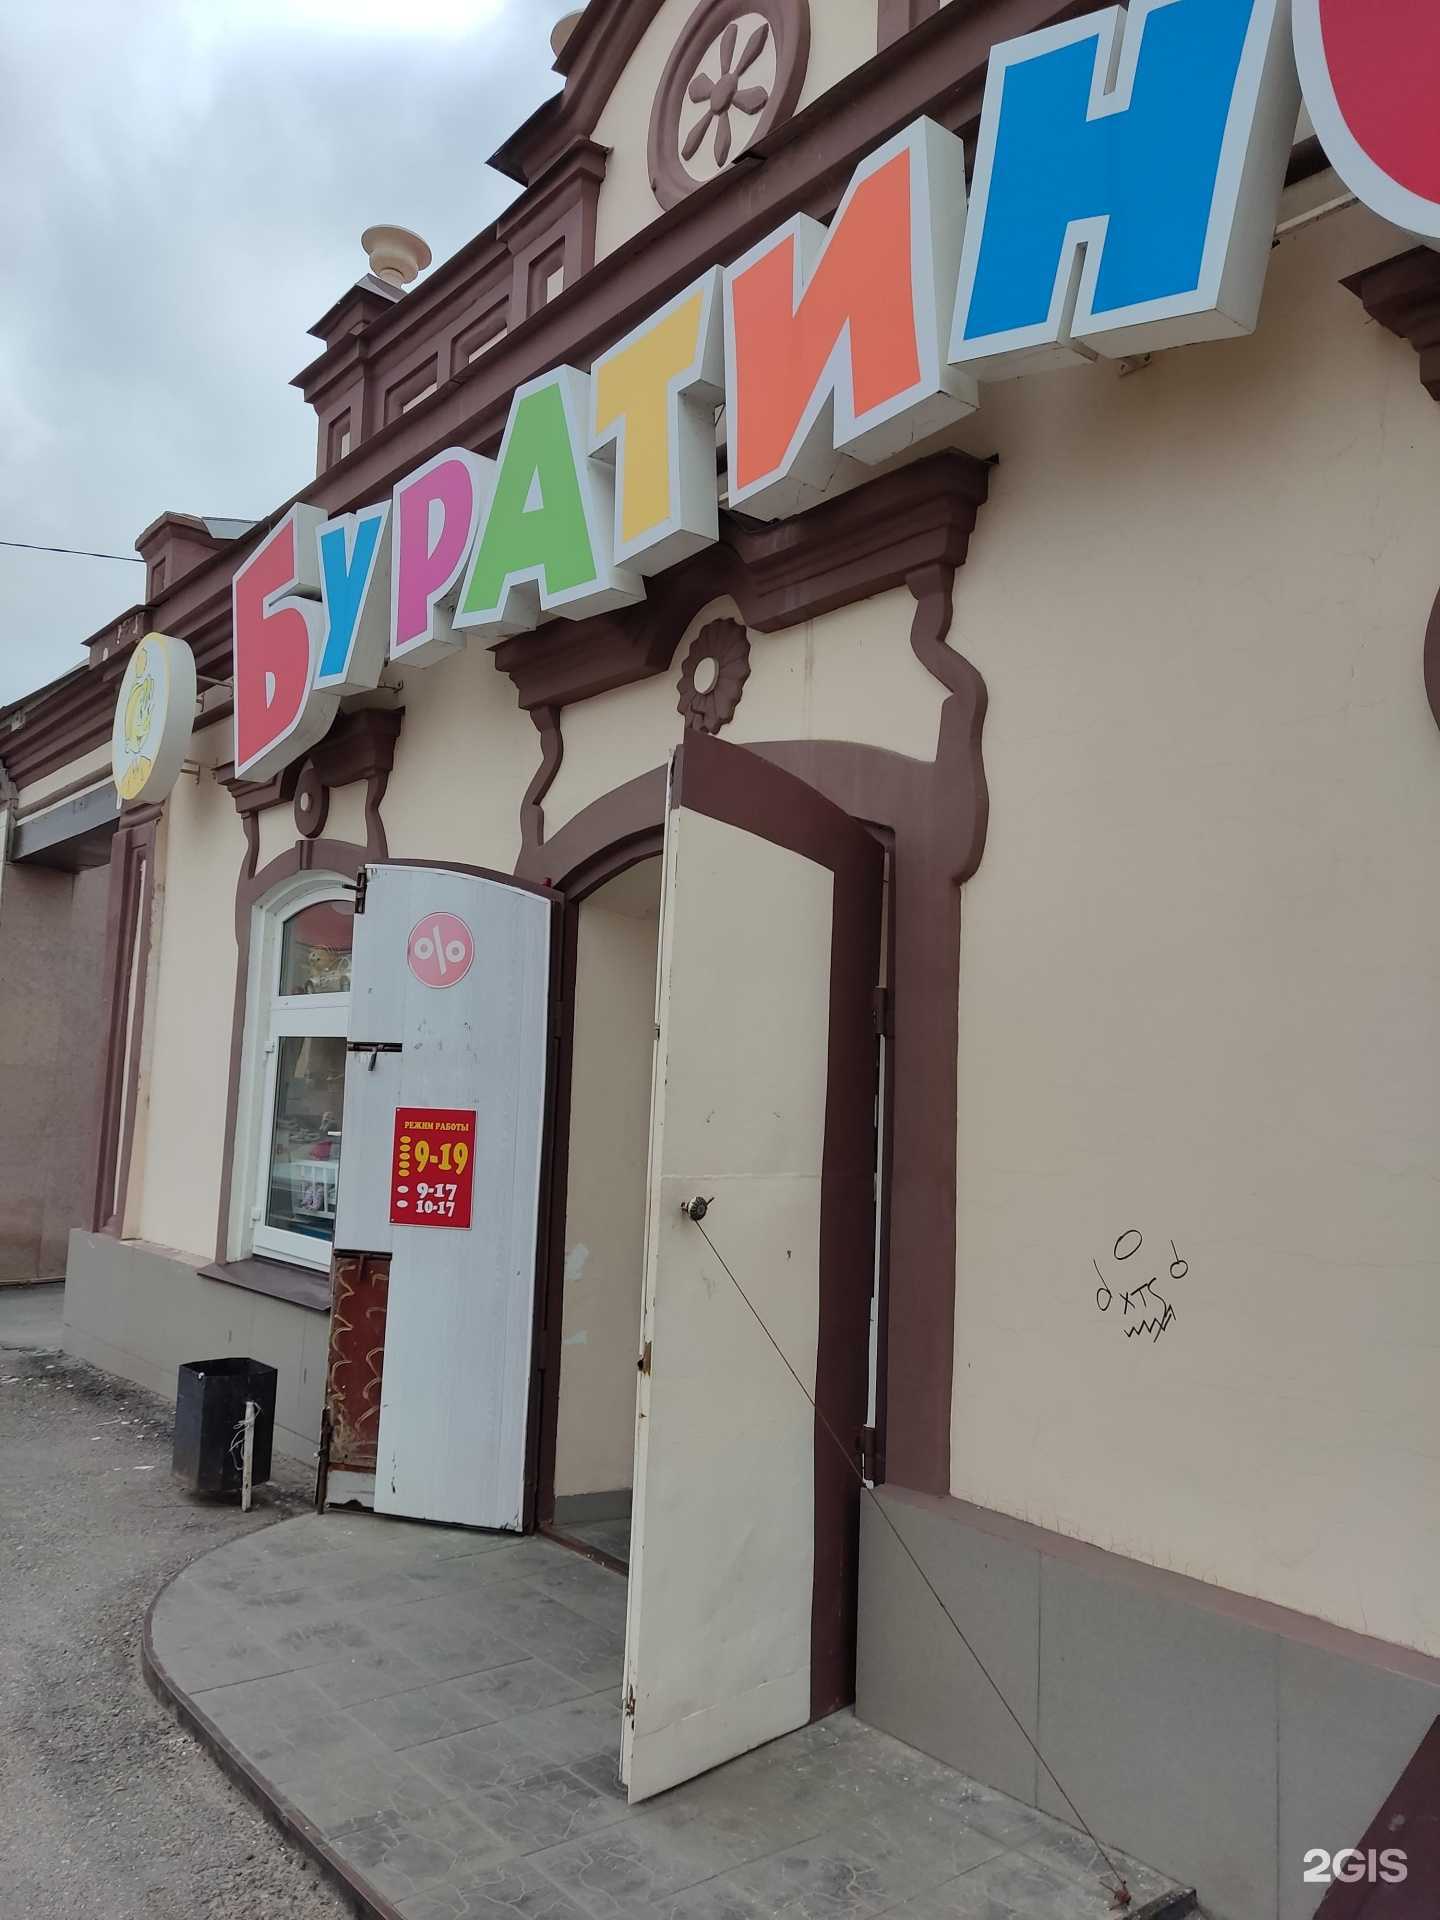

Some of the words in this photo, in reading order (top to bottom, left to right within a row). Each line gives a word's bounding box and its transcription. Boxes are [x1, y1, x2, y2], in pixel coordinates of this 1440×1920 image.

[404, 1121, 434, 1130] РЕЖИМ
[435, 1122, 469, 1131] РАБОТЫ
[414, 1140, 469, 1175] 9-19
[416, 1182, 458, 1201] 9-17
[415, 1200, 456, 1218] 10-17
